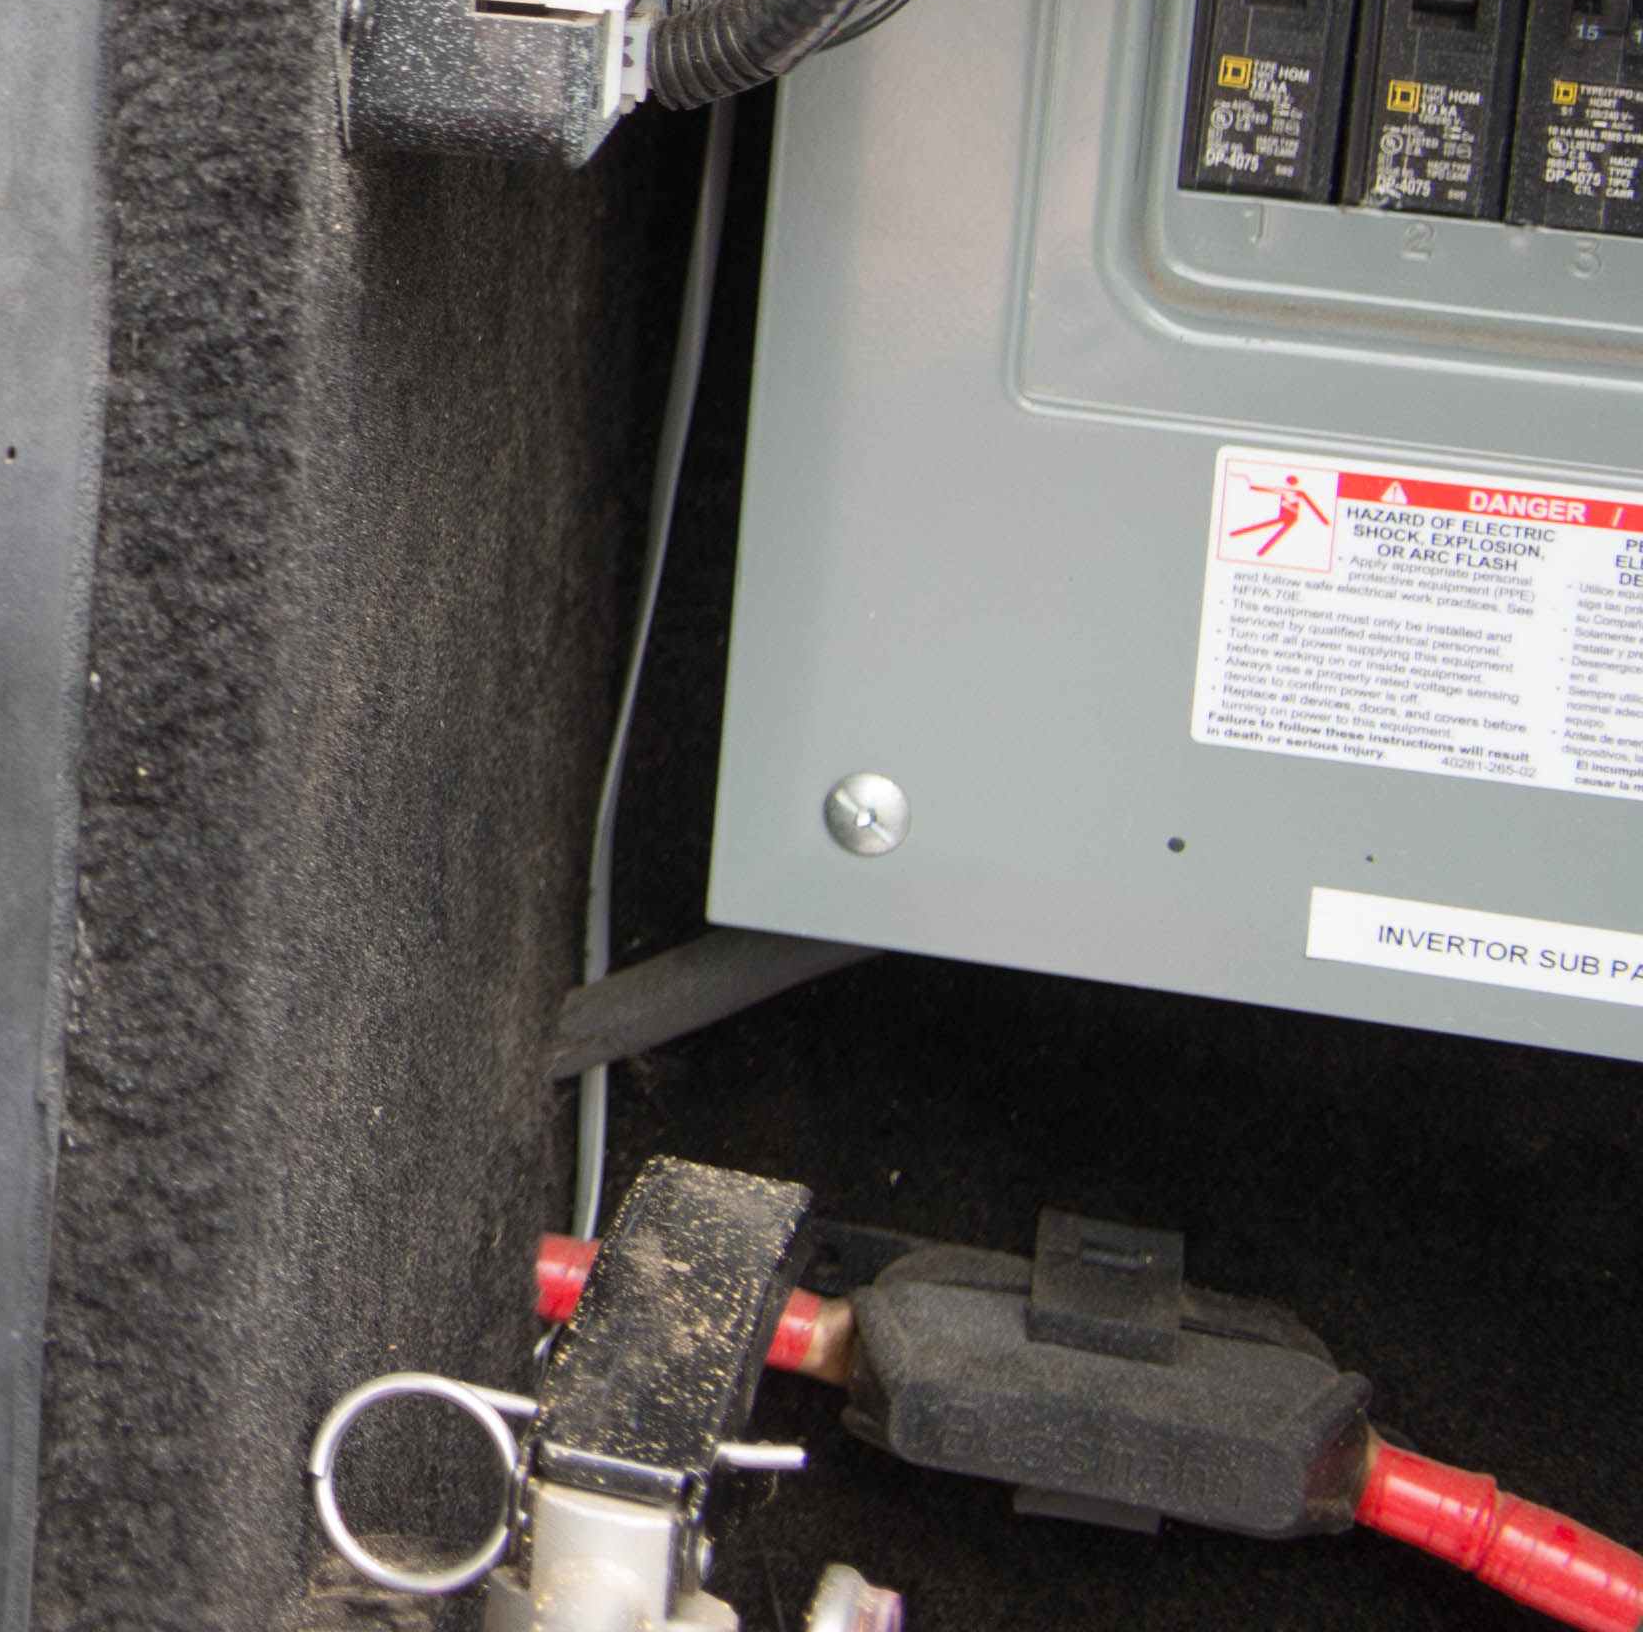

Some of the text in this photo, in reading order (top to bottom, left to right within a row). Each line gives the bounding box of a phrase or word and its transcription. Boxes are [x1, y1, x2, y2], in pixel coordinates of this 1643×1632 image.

[1278, 66, 1311, 83] HOM
[1449, 89, 1483, 106] HOM
[1545, 168, 1602, 187] DP-4075
[1243, 202, 1267, 246] 1
[1402, 222, 1434, 263] 2
[1569, 239, 1603, 281] 3
[1468, 489, 1588, 524] DANGER
[1347, 506, 1556, 543] HAZARD OF ELECTRIC
[1353, 524, 1545, 561] SHOCK, EXPLOSION,
[1377, 543, 1518, 572] OR ARC FLASH
[1348, 569, 1535, 603] protective equipment (PPE)
[1350, 555, 1533, 587] Apply appropriate personal
[1233, 585, 1271, 599] NFPA
[1234, 571, 1534, 616] and follow safe electrical work practices. See
[1229, 614, 1428, 647] serviced by qualified electrical
[1233, 598, 1513, 643] This equipment must only be installed and
[1226, 642, 1406, 674] before working on or inside
[1230, 627, 1513, 673] Turn off all power supplying this equipment
[1224, 670, 1267, 684] device
[1271, 676, 1283, 686] to
[1287, 678, 1337, 693] confirm
[1340, 686, 1381, 699] power
[1386, 691, 1396, 701] is
[1226, 655, 1520, 704] Always use properly rated voltage sensing
[1221, 699, 1267, 716] turning
[1270, 706, 1287, 717] on
[1291, 709, 1331, 722] power
[1336, 714, 1350, 724] to
[1353, 716, 1376, 728] this
[1223, 684, 1527, 733] Replace all devices, doors, and covers before
[1206, 725, 1220, 736] in
[1224, 729, 1263, 742] death
[1267, 735, 1281, 744] or
[1286, 738, 1339, 752] serious
[1208, 711, 1530, 763] Failure to follow these instructions will result
[1378, 925, 1528, 966] INVERTOR
[1539, 948, 1601, 976] SUB
